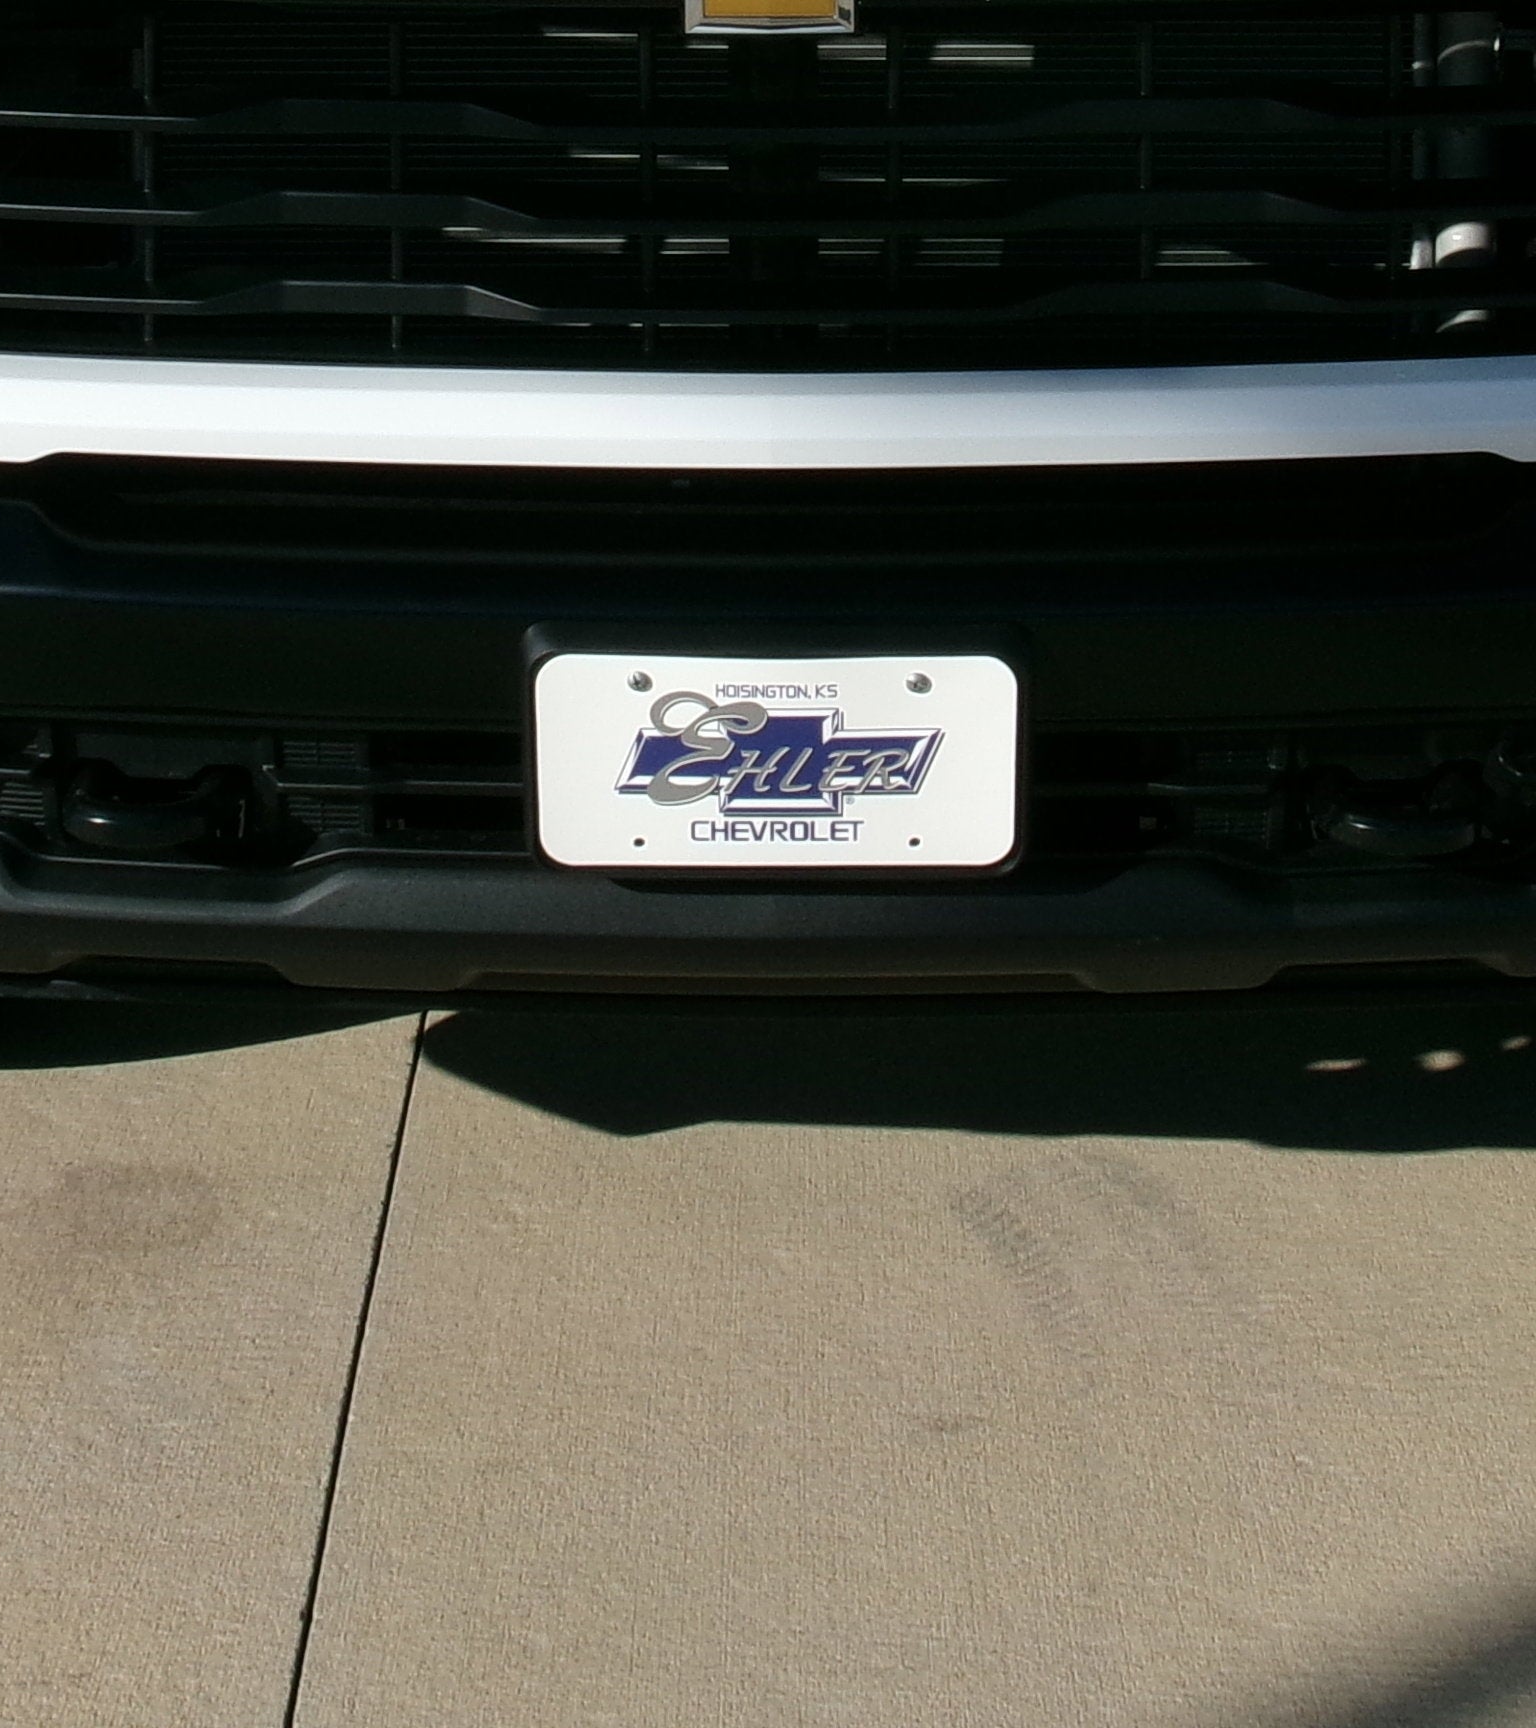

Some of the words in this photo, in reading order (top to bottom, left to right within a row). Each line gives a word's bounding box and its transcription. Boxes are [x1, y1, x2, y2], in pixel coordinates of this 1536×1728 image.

[715, 684, 812, 700] HOISINGTON,
[815, 684, 838, 699] KS
[690, 820, 865, 842] CHEVROLET
